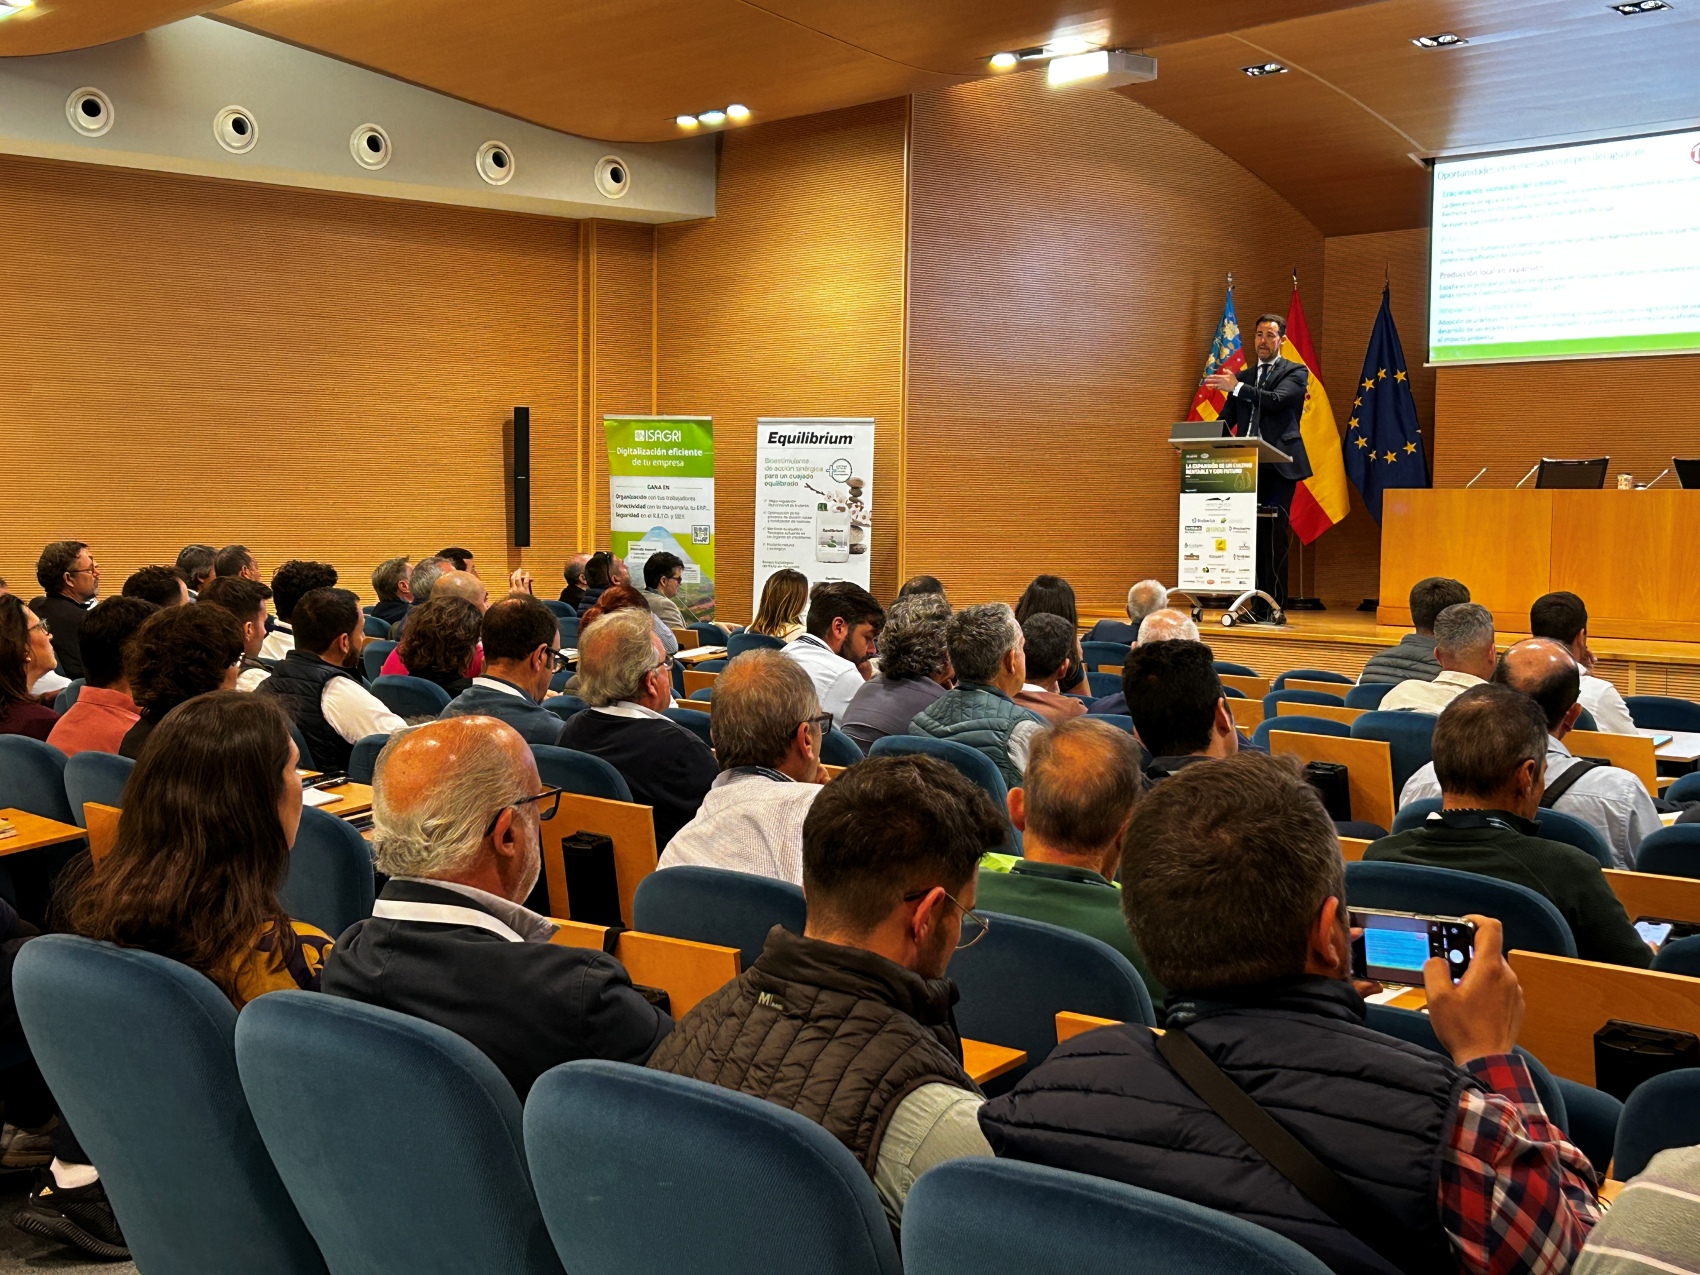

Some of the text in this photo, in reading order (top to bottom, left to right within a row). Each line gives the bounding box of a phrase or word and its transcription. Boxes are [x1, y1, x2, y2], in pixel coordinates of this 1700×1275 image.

[1440, 270, 1478, 280] Producción
[1480, 268, 1496, 276] local
[646, 430, 681, 442] ISAGRI
[768, 431, 853, 446] Equilibrium
[616, 447, 702, 457] Digitalización eficiente
[652, 460, 684, 468] empresa
